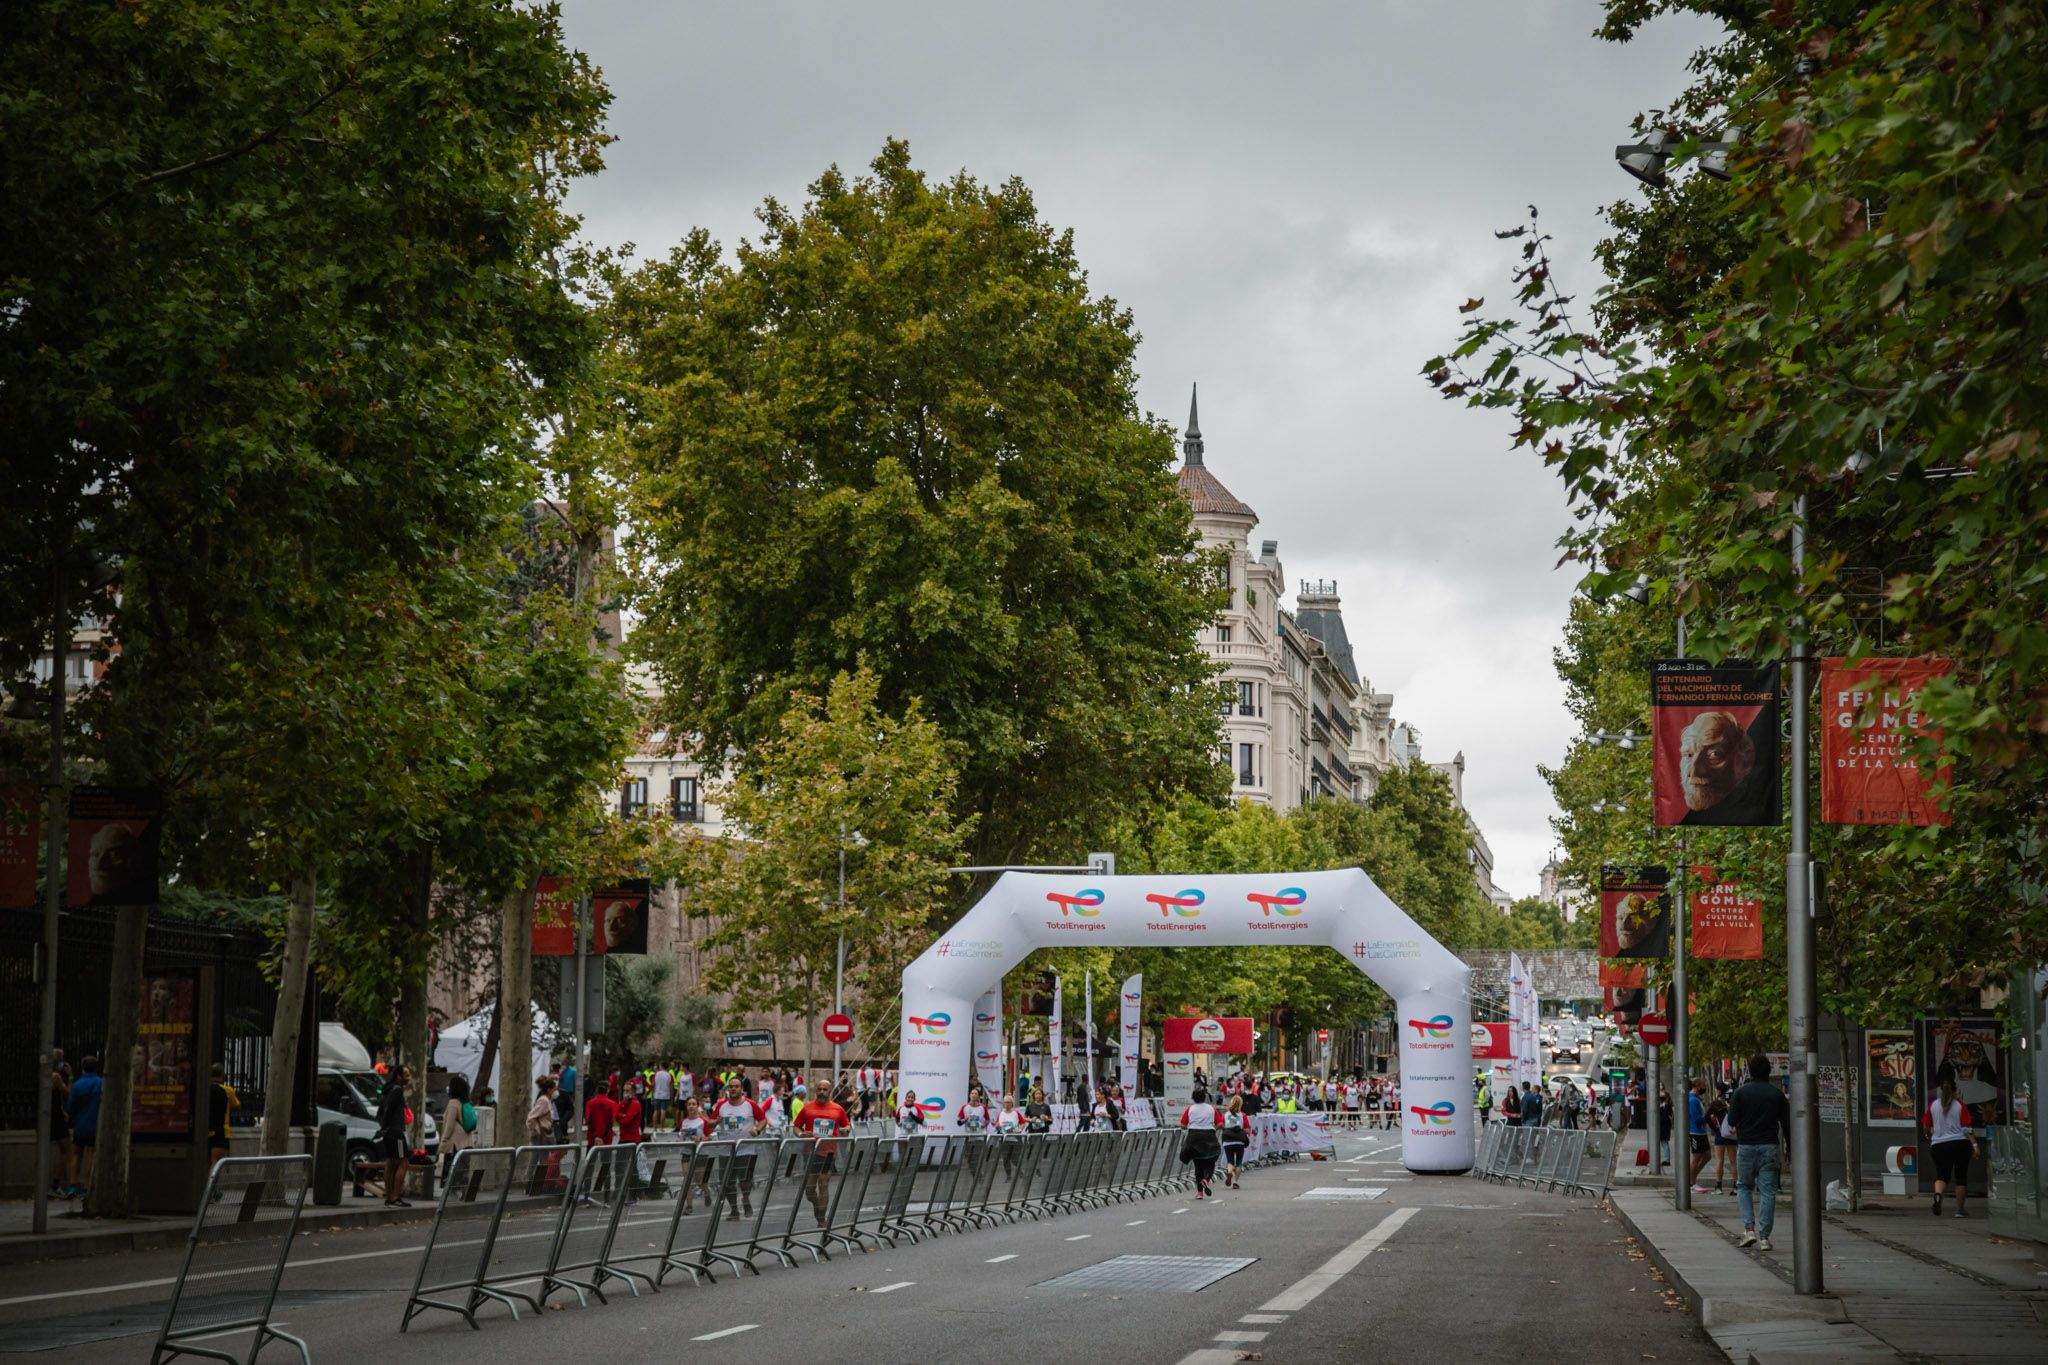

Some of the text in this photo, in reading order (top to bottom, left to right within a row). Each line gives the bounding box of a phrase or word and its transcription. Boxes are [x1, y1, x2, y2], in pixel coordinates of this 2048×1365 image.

[1657, 663, 1667, 671] 28
[1686, 663, 1696, 671] 31
[1657, 675, 1713, 683] CENTENARIO
[1657, 684, 1743, 692] DEL NACIMIENTO DE
[1657, 693, 1705, 701] FERNANDO
[1838, 759, 1861, 769] DE
[1865, 759, 1885, 769] LA
[1046, 921, 1106, 931] TotalEnergies
[1146, 922, 1206, 932] TotalEnergies
[1248, 922, 1308, 931] TotalEnergies
[907, 1038, 950, 1048] TotalEnergies
[1408, 1042, 1454, 1051] TotalEnergies
[905, 1070, 948, 1078] totalenergies.es
[1818, 1066, 1857, 1074] COMPO
[1411, 1128, 1456, 1137] TotalEnergies
